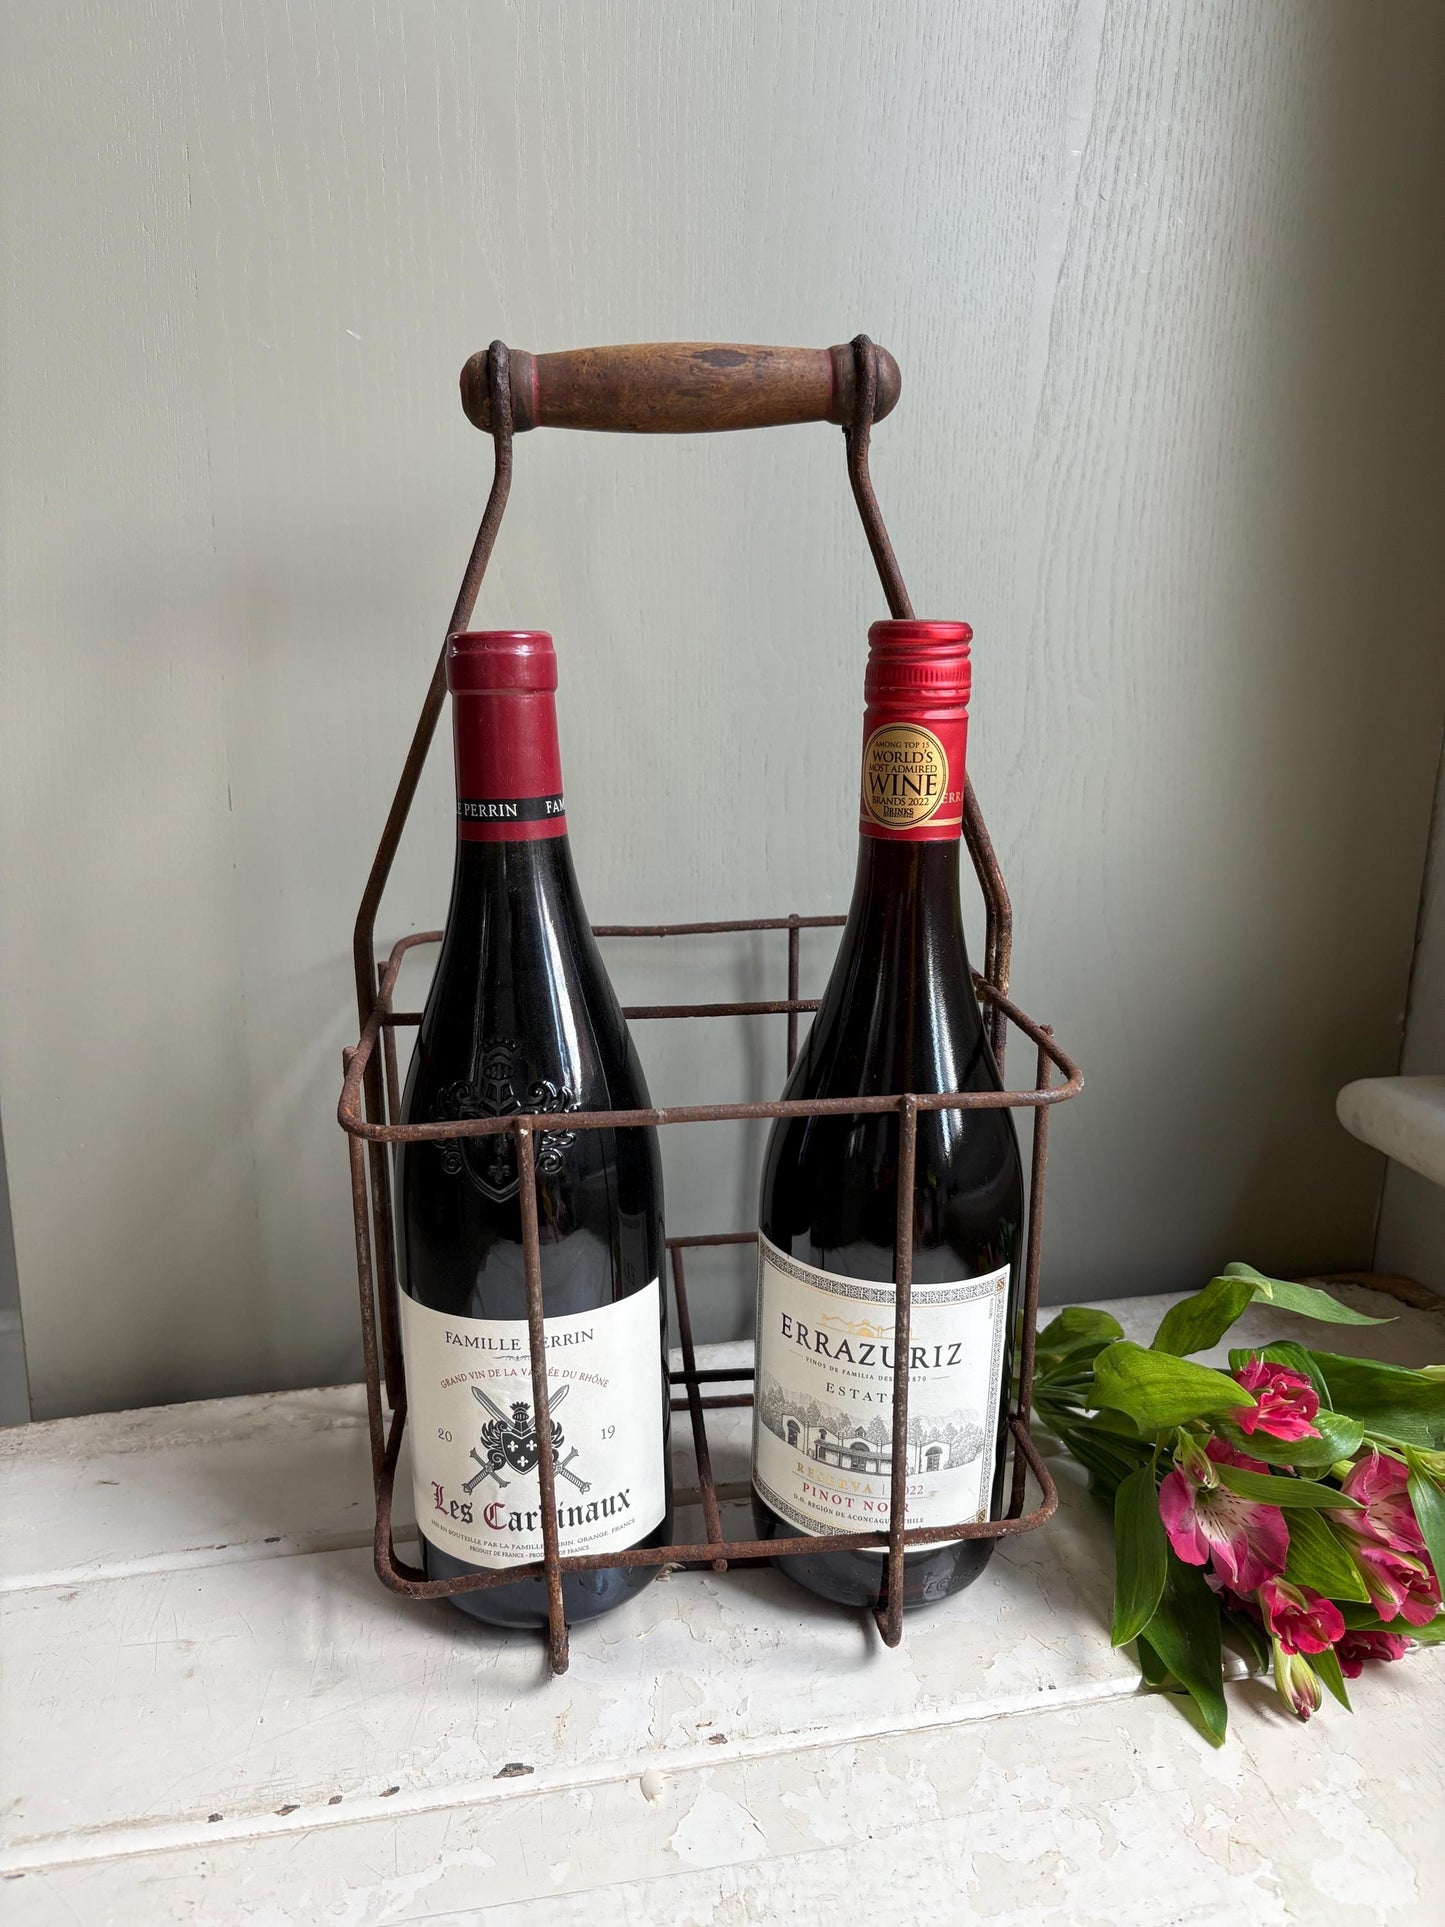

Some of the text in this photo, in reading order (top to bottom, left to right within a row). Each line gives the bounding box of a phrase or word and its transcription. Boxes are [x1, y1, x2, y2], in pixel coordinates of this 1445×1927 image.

[872, 749, 933, 764] WORLD'S
[869, 763, 938, 774] MOST ADMIRED
[868, 772, 938, 797] WINE
[464, 803, 518, 817] PERRIN
[872, 795, 930, 807] BRANDS 2022
[444, 1328, 595, 1351] FAMILLE ERRIN
[781, 1312, 963, 1369] ERRAZURIZ
[440, 1366, 610, 1389] GRAND VIN DE LA VAÉE DU RHÔNE
[805, 1356, 827, 1369] VINOS
[829, 1365, 839, 1373] DE
[841, 1369, 874, 1380] FAMILIA
[826, 1381, 896, 1404] ESTAT
[437, 1427, 453, 1443] 20
[600, 1425, 616, 1440] 19
[796, 1461, 924, 1495] RESERVA 022
[431, 1480, 631, 1532] Les Carinaux
[802, 1482, 910, 1513] PINOT NOR
[807, 1499, 834, 1515] REGIÓN
[835, 1510, 846, 1518] DE
[847, 1513, 891, 1525] ACONCAGU
[483, 1540, 498, 1548] PAR
[611, 1517, 636, 1534] FRANCE
[567, 1545, 590, 1555] FRANCE
